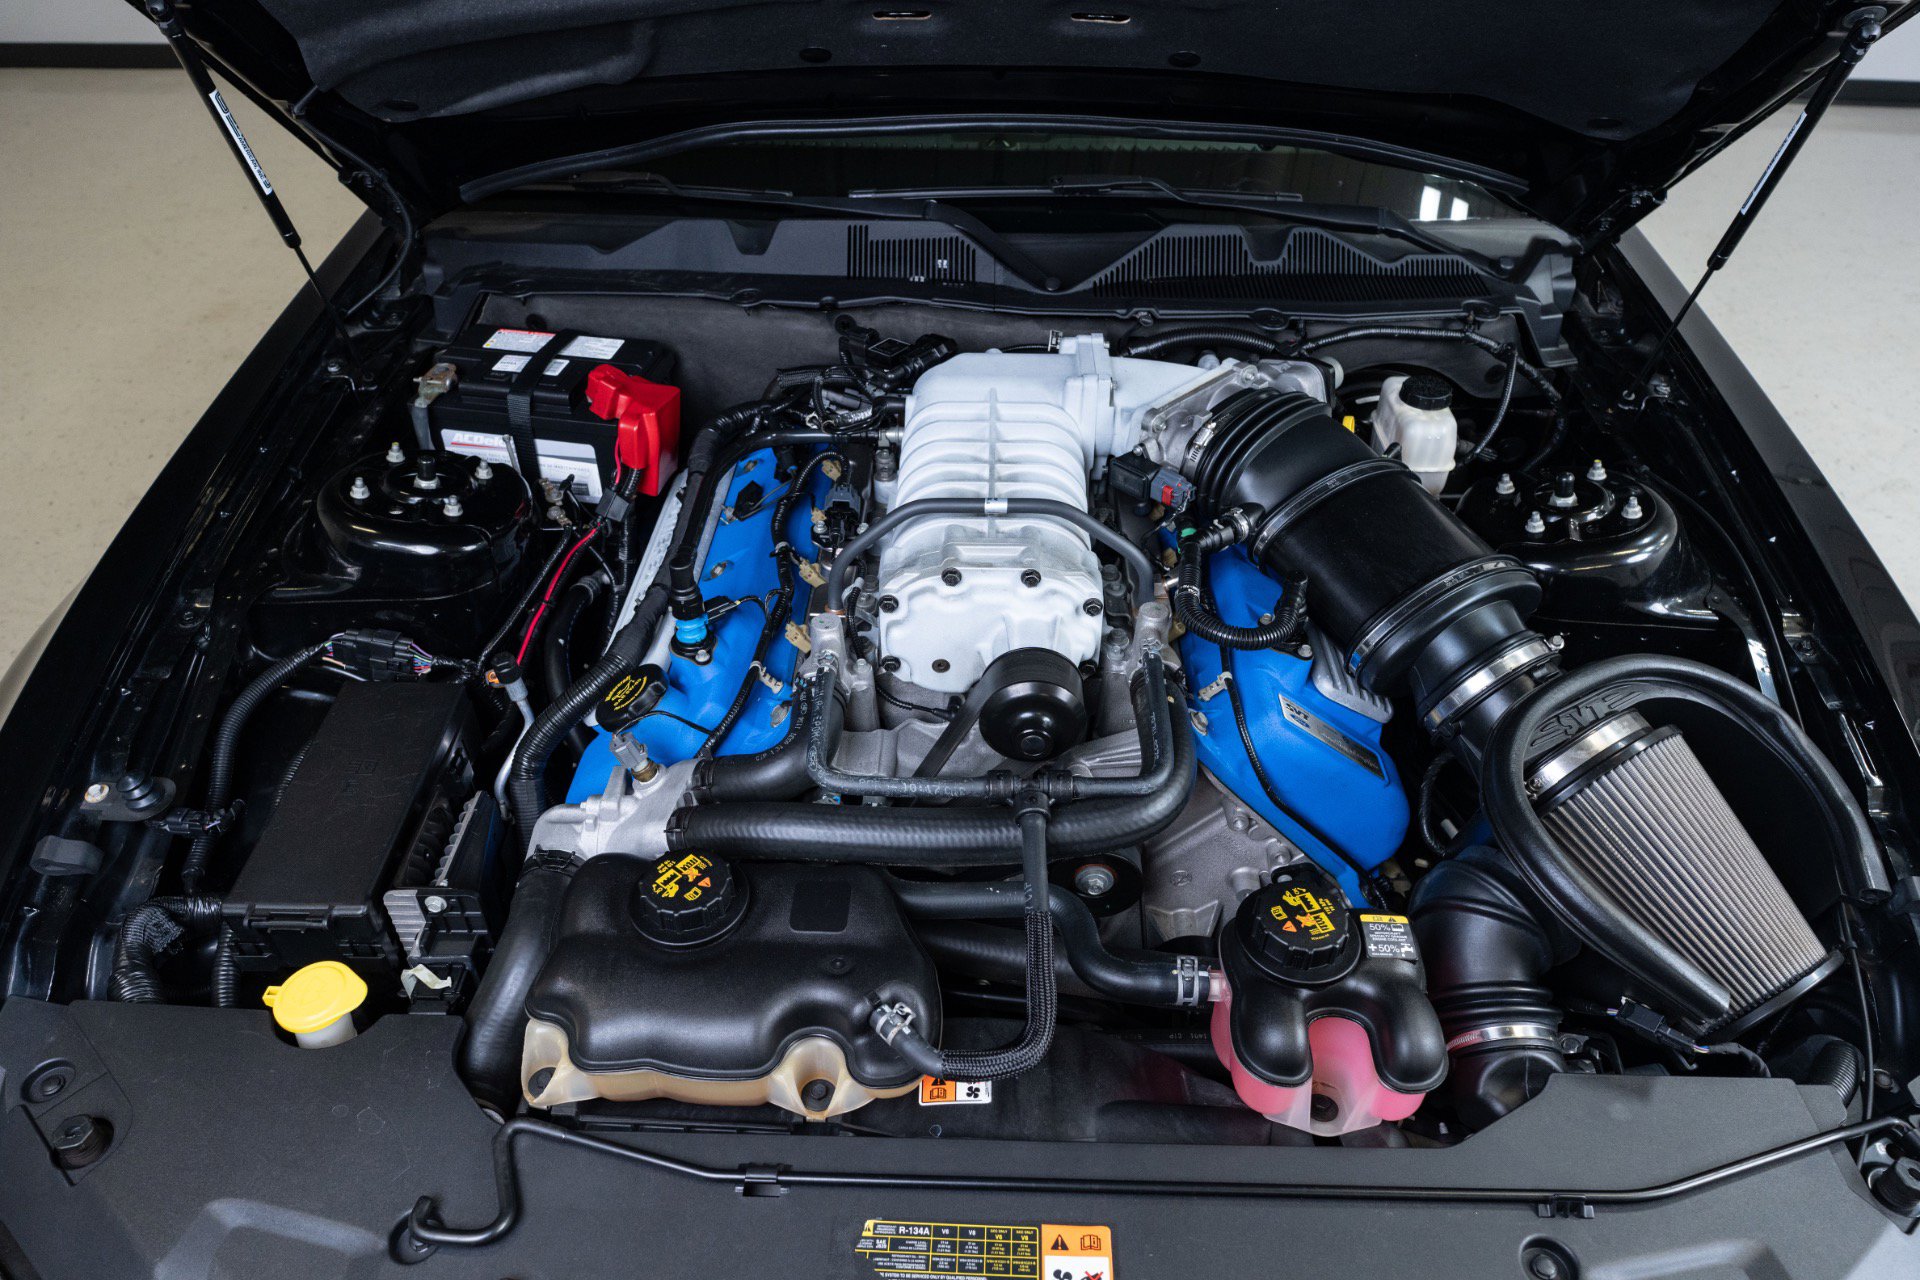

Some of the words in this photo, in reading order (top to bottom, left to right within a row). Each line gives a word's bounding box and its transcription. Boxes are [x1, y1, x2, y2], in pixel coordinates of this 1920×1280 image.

[1556, 698, 1609, 737] SVT
[1369, 923, 1391, 931] 50%
[1378, 944, 1400, 953] 50%
[898, 1226, 930, 1236] R-134A
